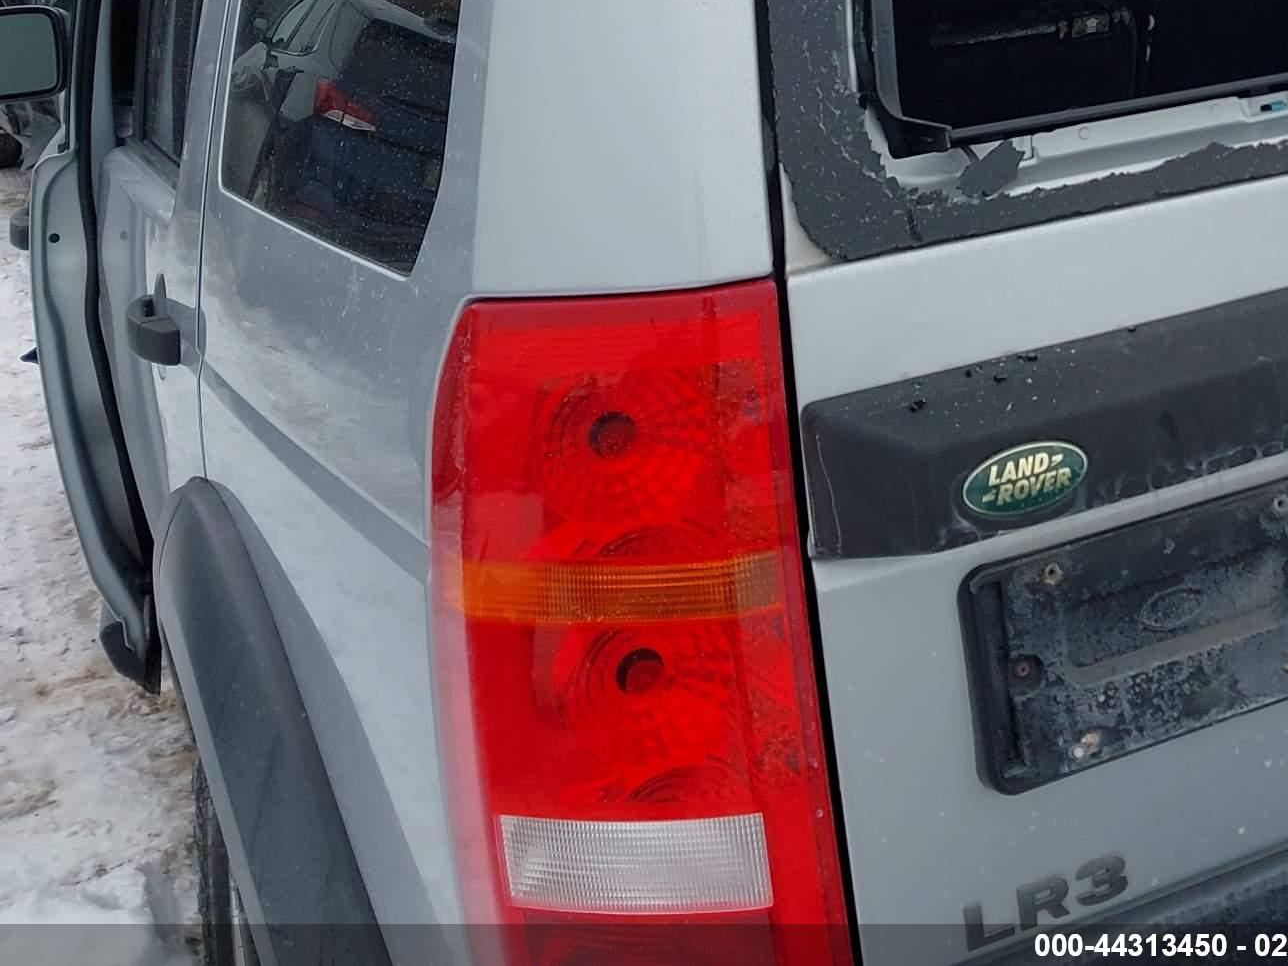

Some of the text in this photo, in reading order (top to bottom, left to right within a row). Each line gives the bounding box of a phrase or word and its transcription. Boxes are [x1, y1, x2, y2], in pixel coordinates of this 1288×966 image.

[989, 452, 1049, 487] LAND
[996, 467, 1072, 506] ROVER
[962, 855, 1129, 952] LR3
